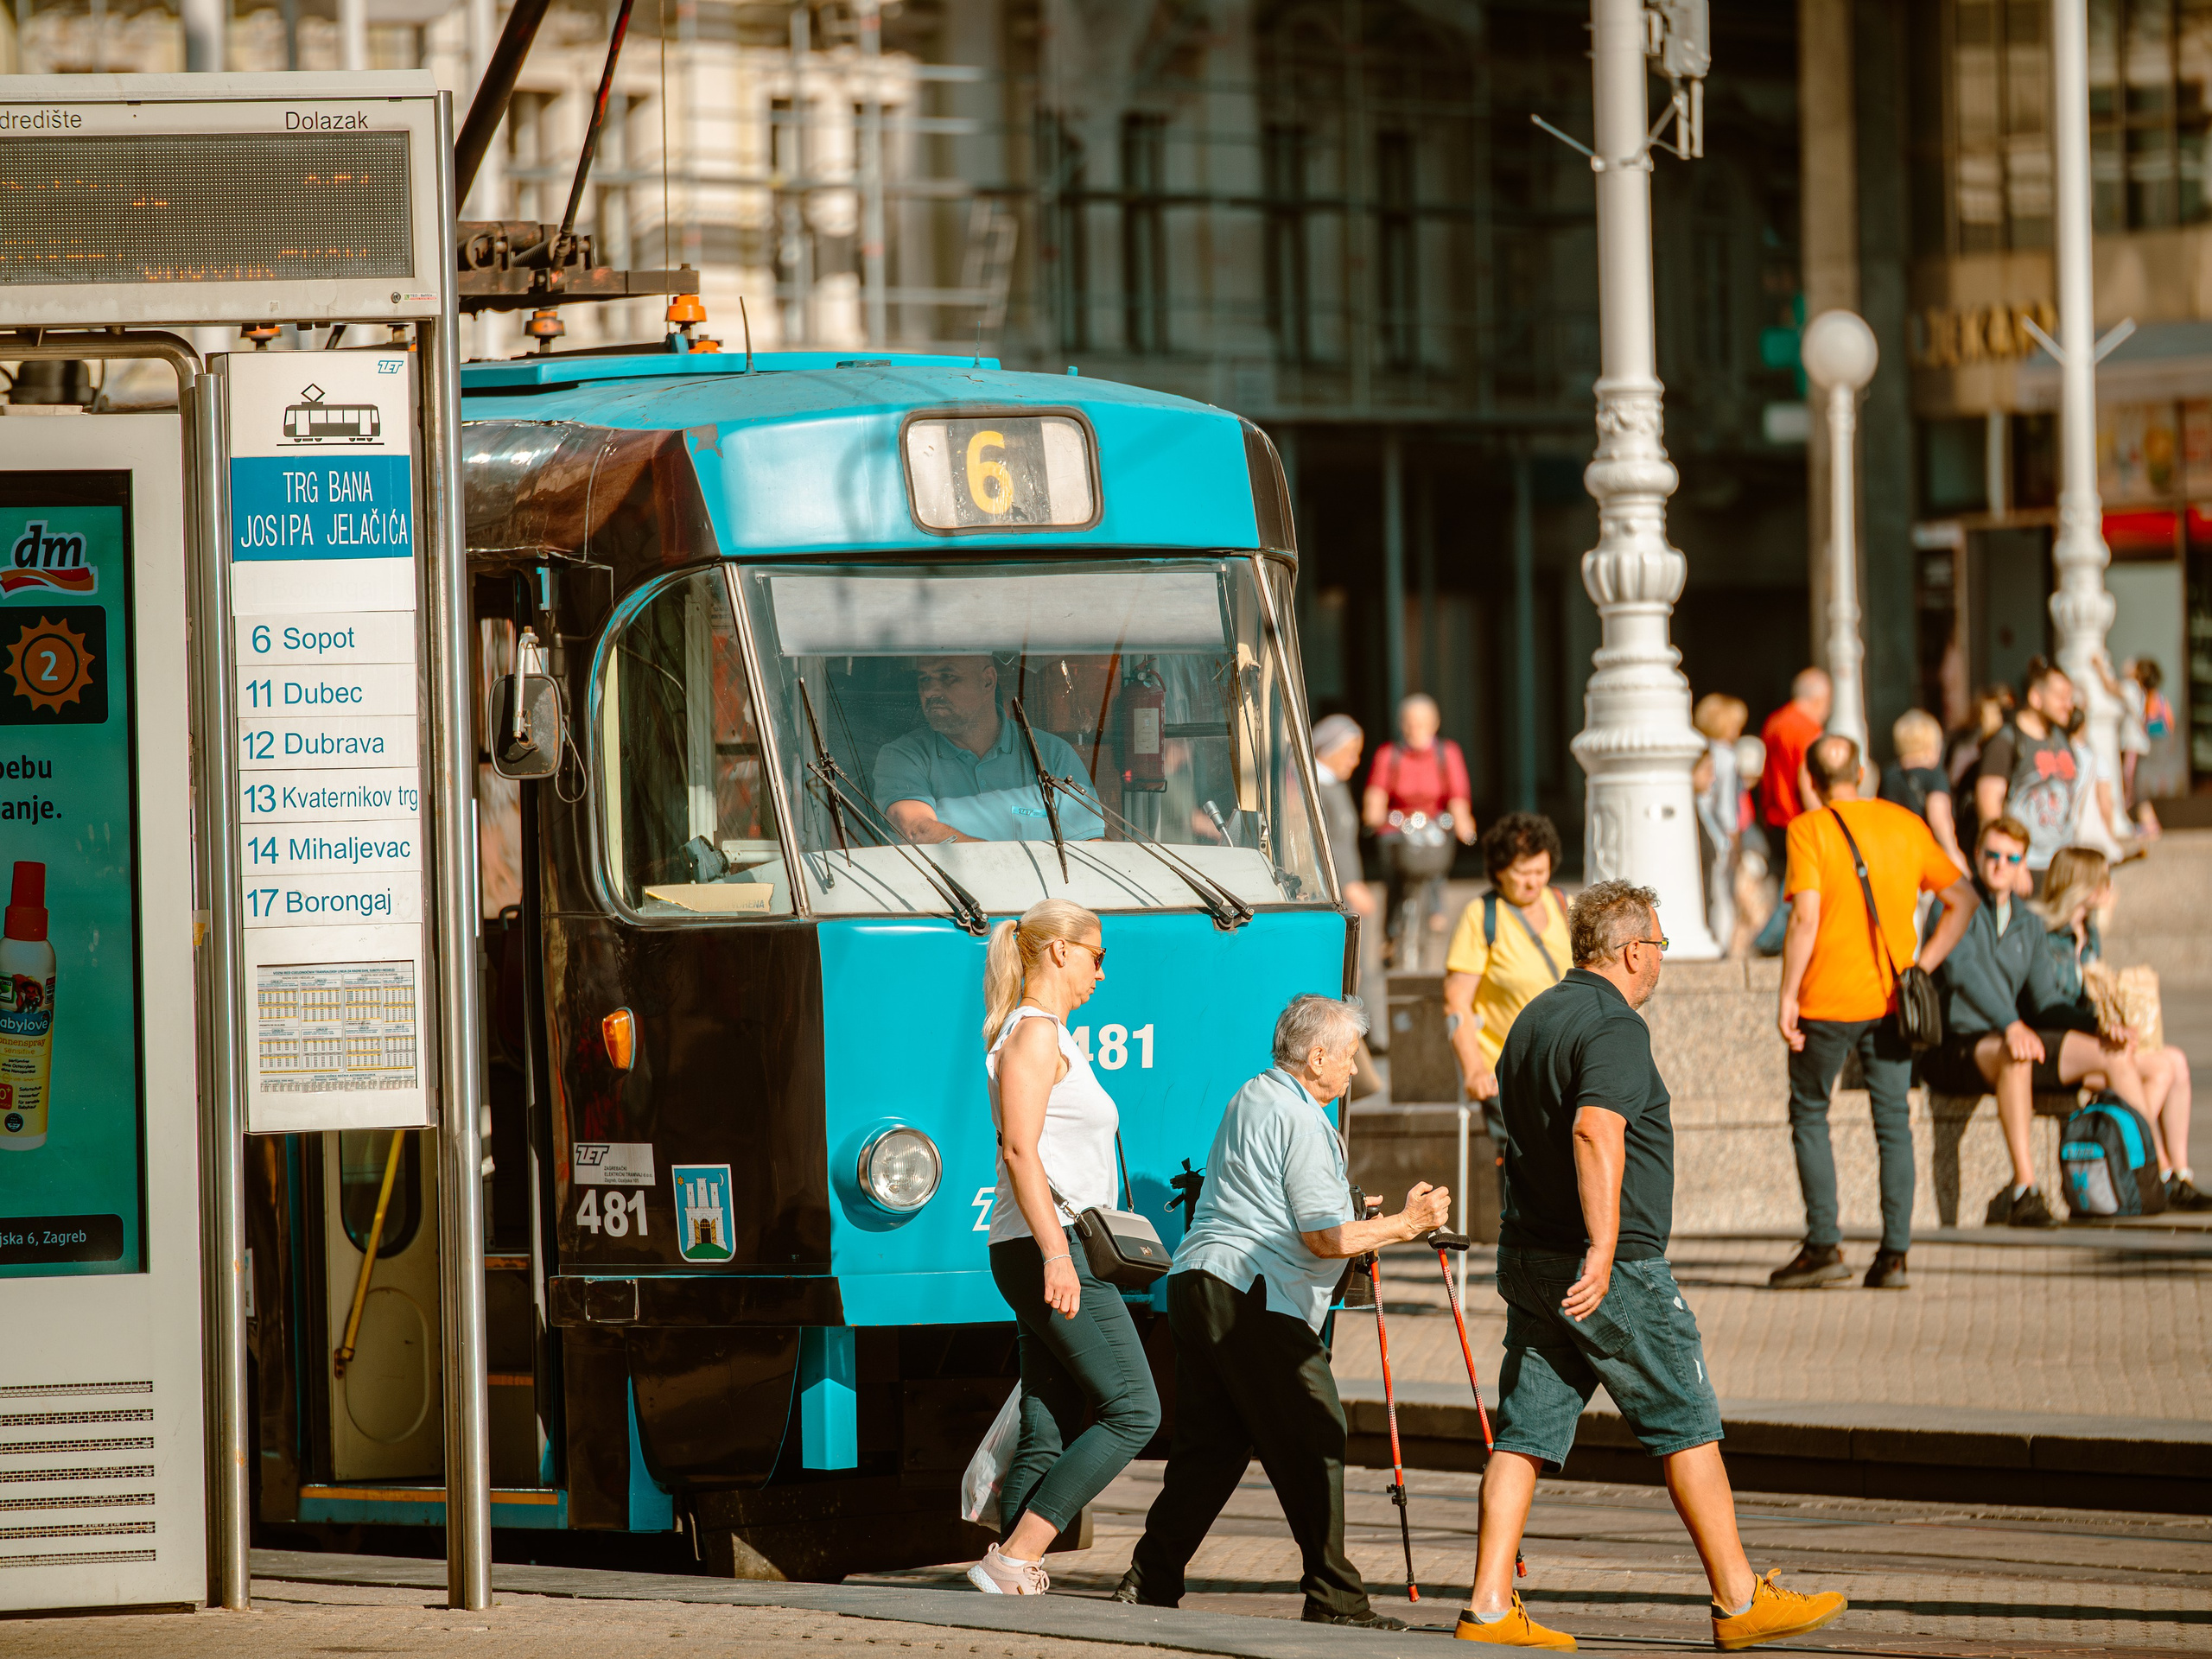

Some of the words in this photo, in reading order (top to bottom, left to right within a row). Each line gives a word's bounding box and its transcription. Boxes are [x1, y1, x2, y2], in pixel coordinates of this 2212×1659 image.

[0, 110, 82, 129] dredište
[286, 111, 369, 130] Dolazak
[378, 360, 404, 373] ZET
[283, 472, 318, 503] TRG
[328, 471, 373, 502] BANA
[967, 430, 1014, 515] 6
[240, 513, 314, 548] JOSIPA
[327, 508, 409, 545] JELAČIĆA
[15, 524, 82, 569] dm
[251, 625, 271, 653] 6
[283, 627, 355, 654] Sopot
[40, 650, 59, 681] 2
[245, 679, 272, 708] 11
[283, 682, 363, 704] Dubec
[242, 731, 275, 760] 12
[284, 733, 385, 754] Dubrava
[2, 795, 61, 825] anje.
[244, 784, 276, 813] 13
[283, 786, 391, 809] Kvaternikov
[398, 785, 418, 811] trg
[247, 836, 279, 864] 14
[289, 837, 410, 865] Mihaljevac
[246, 888, 279, 917] 17
[286, 887, 391, 916] Borongaj
[575, 1145, 610, 1166] ZET
[576, 1189, 648, 1237] 481
[28, 1232, 39, 1246] 6,
[43, 1230, 86, 1246] Zagreb
